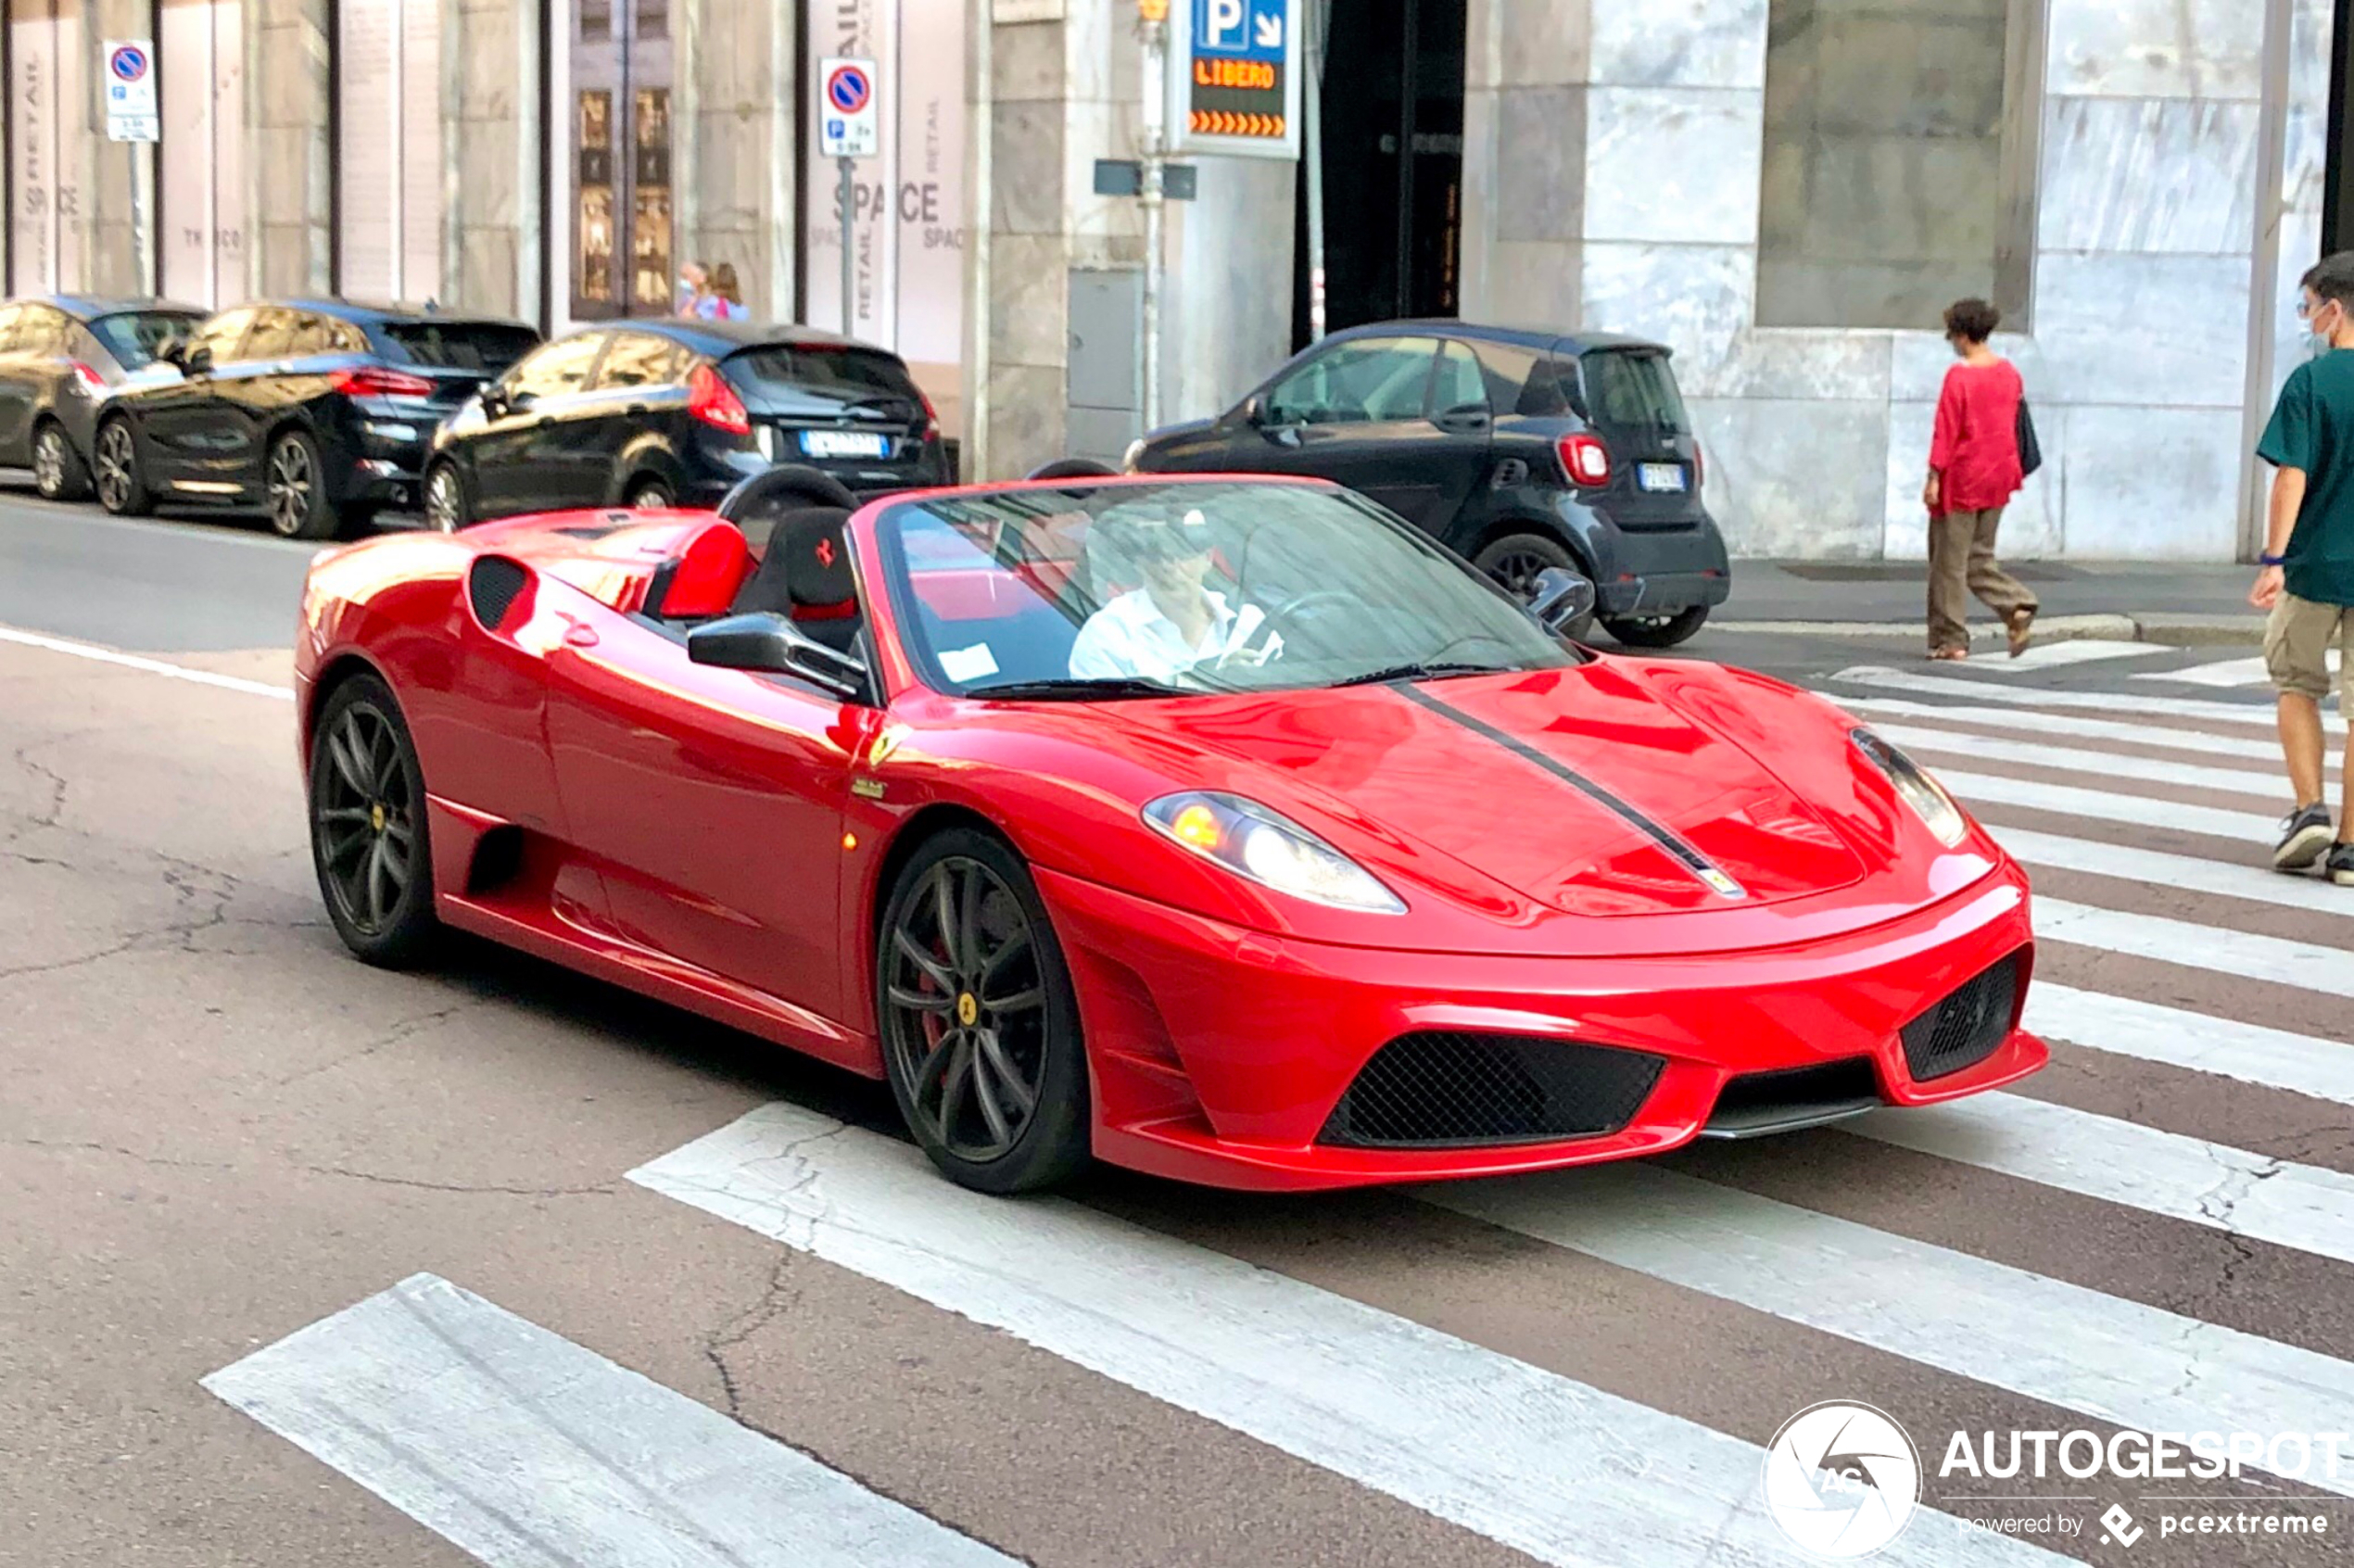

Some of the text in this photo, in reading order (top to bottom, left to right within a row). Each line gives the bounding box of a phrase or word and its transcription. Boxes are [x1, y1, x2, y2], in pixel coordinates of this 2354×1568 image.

[1209, 0, 1242, 45] P
[1196, 58, 1275, 90] LIBERO
[859, 226, 872, 321] RETAIL
